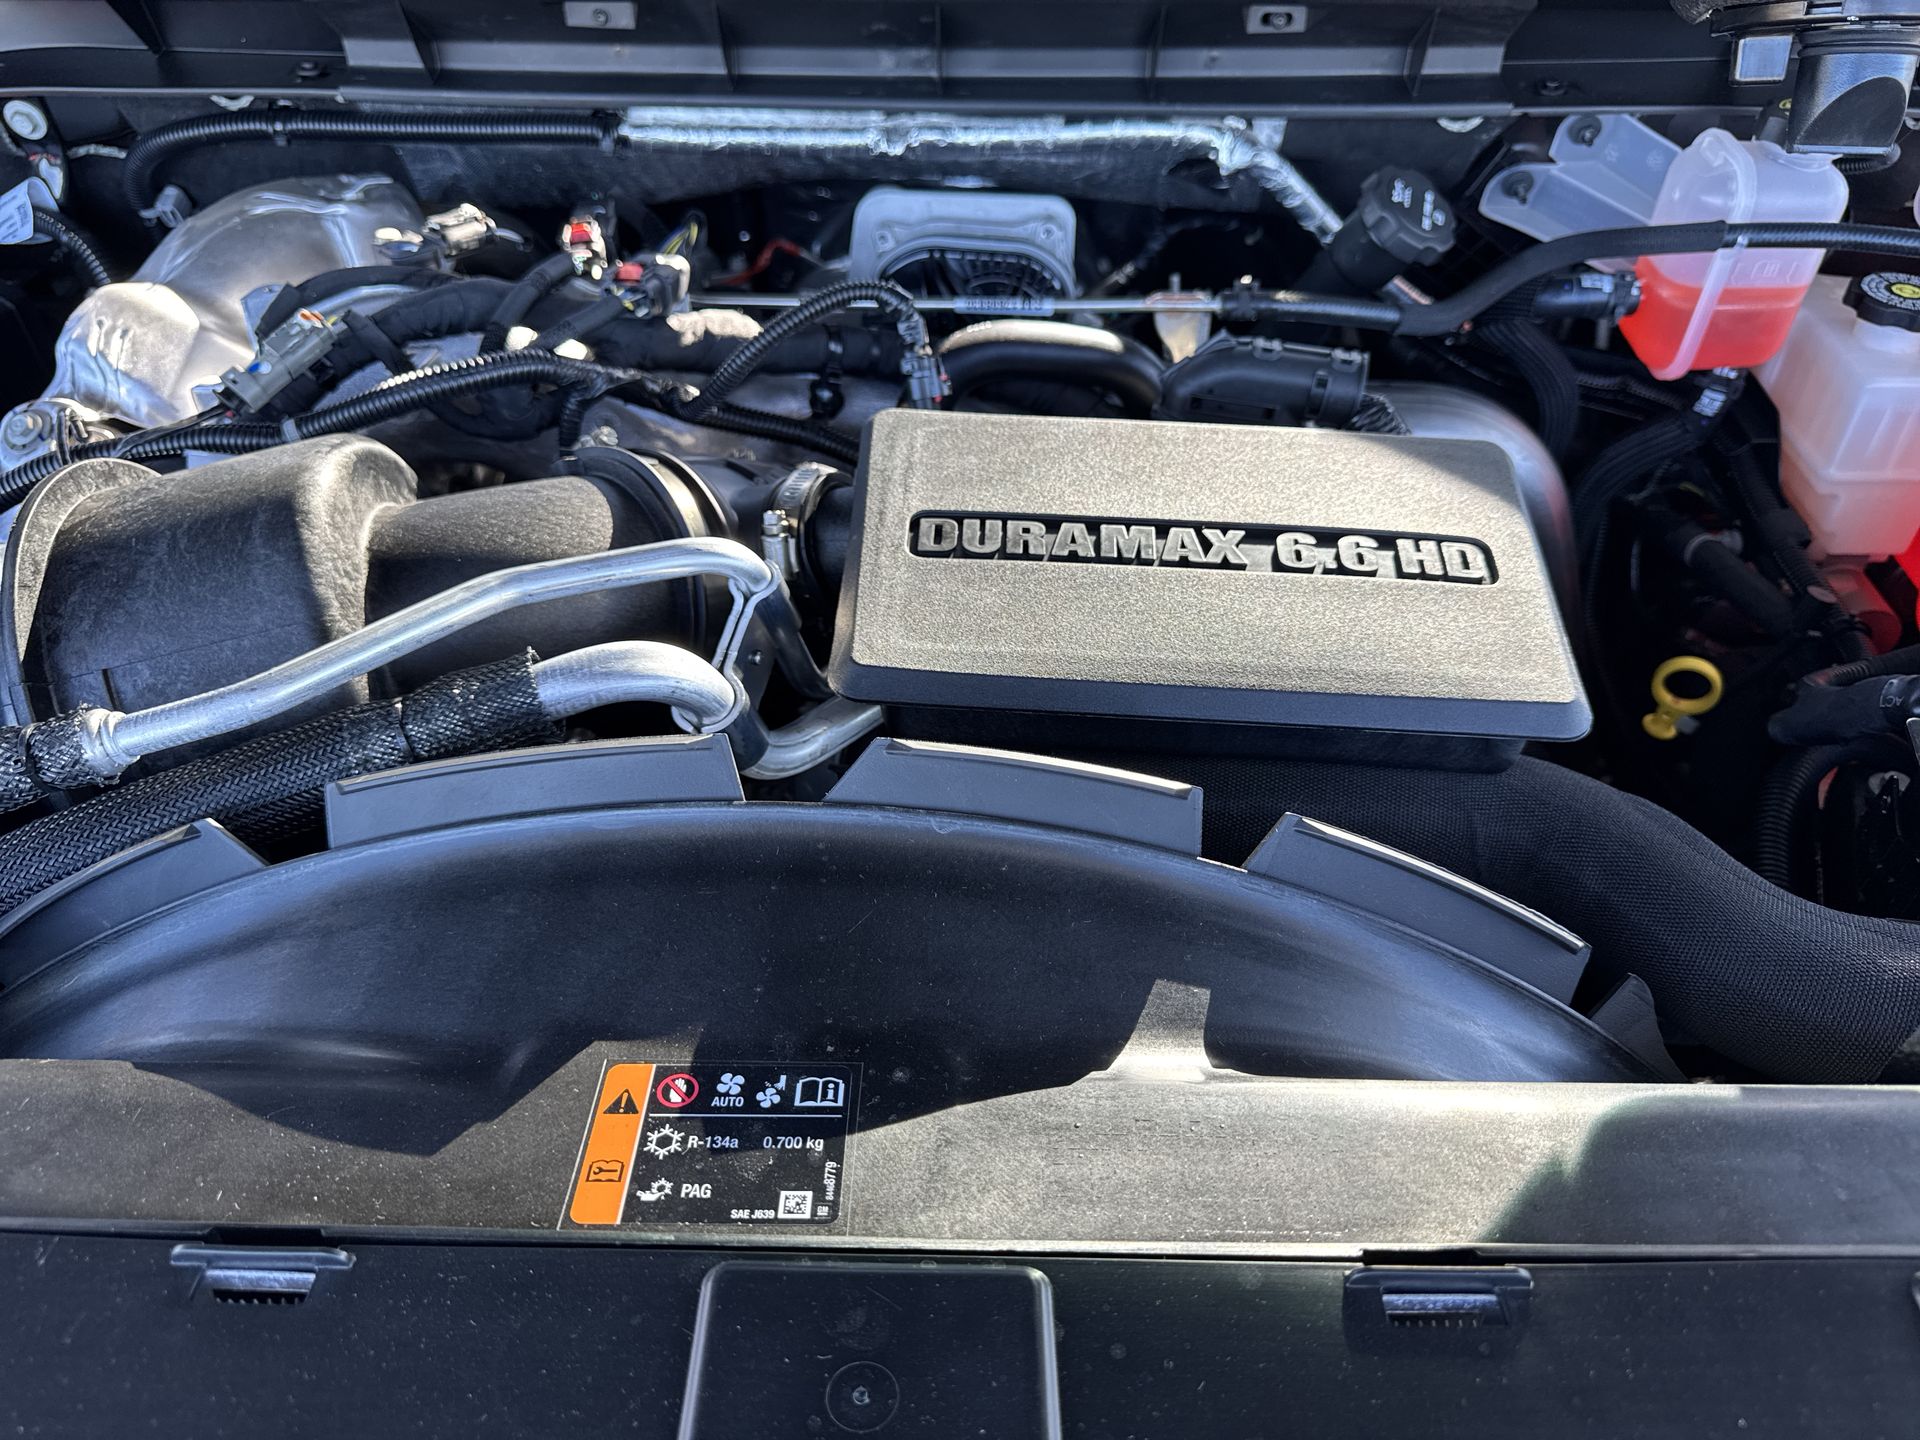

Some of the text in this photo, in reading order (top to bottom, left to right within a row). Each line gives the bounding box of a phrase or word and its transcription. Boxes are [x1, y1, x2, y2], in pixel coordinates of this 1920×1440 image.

[917, 518, 1488, 578] DURAMAX 6.6 HD
[711, 1096, 745, 1107] AUTO
[687, 1135, 824, 1151] R-134a 0.700 kg
[680, 1183, 712, 1199] PAG
[730, 1209, 776, 1219] SAE J639
